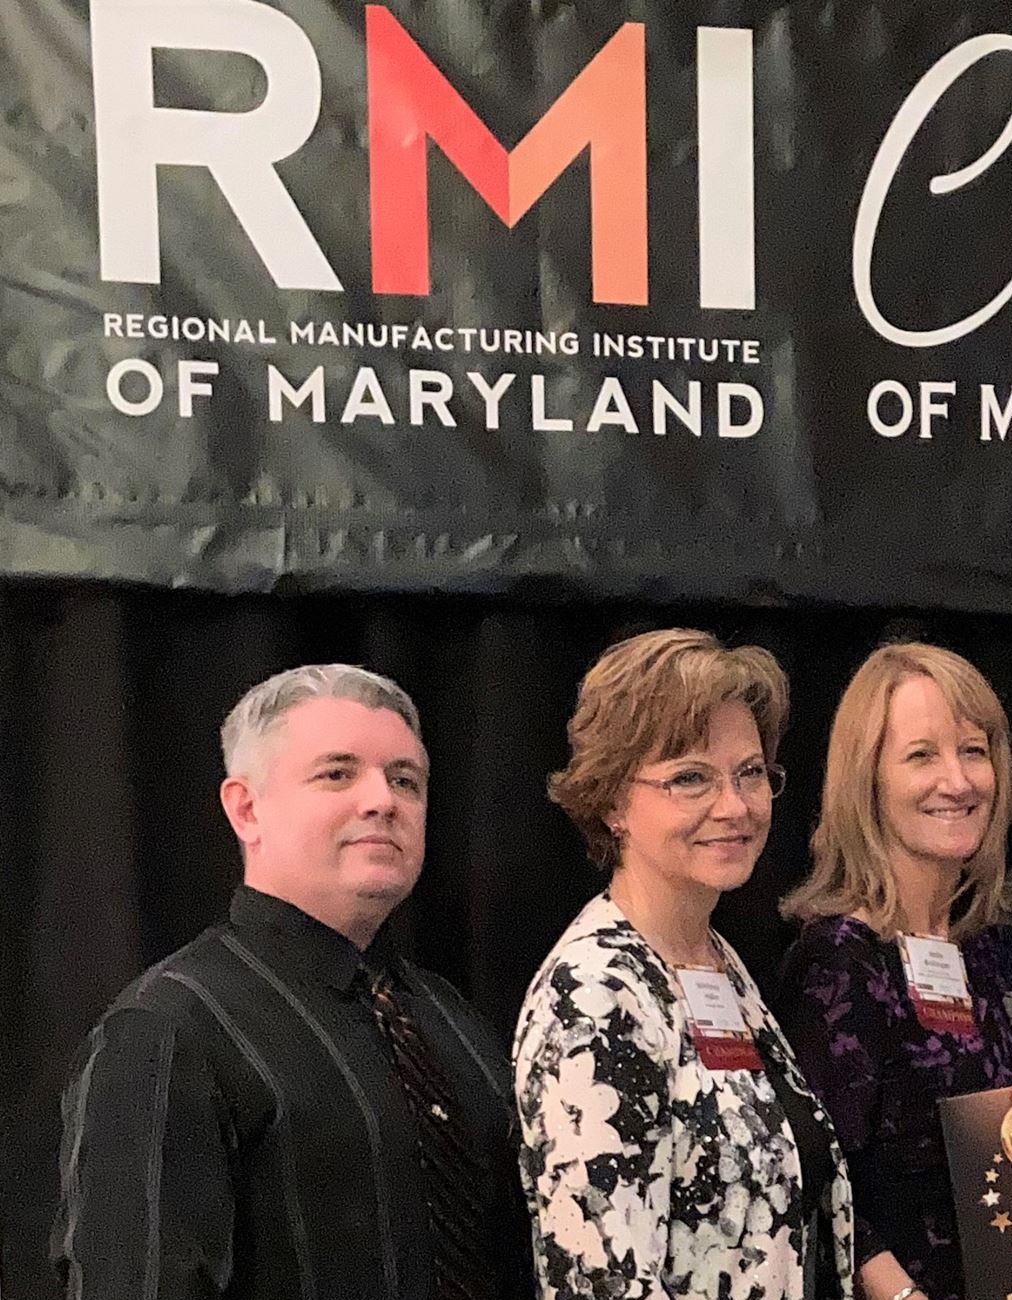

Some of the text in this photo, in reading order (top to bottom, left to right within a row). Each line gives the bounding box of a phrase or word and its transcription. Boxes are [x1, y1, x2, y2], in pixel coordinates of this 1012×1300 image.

[90, 0, 756, 310] RMI
[103, 312, 761, 364] REGIONAL MANUFACTURING INSTITUTE
[106, 358, 764, 438] OF MARYLAND
[867, 379, 956, 439] OF
